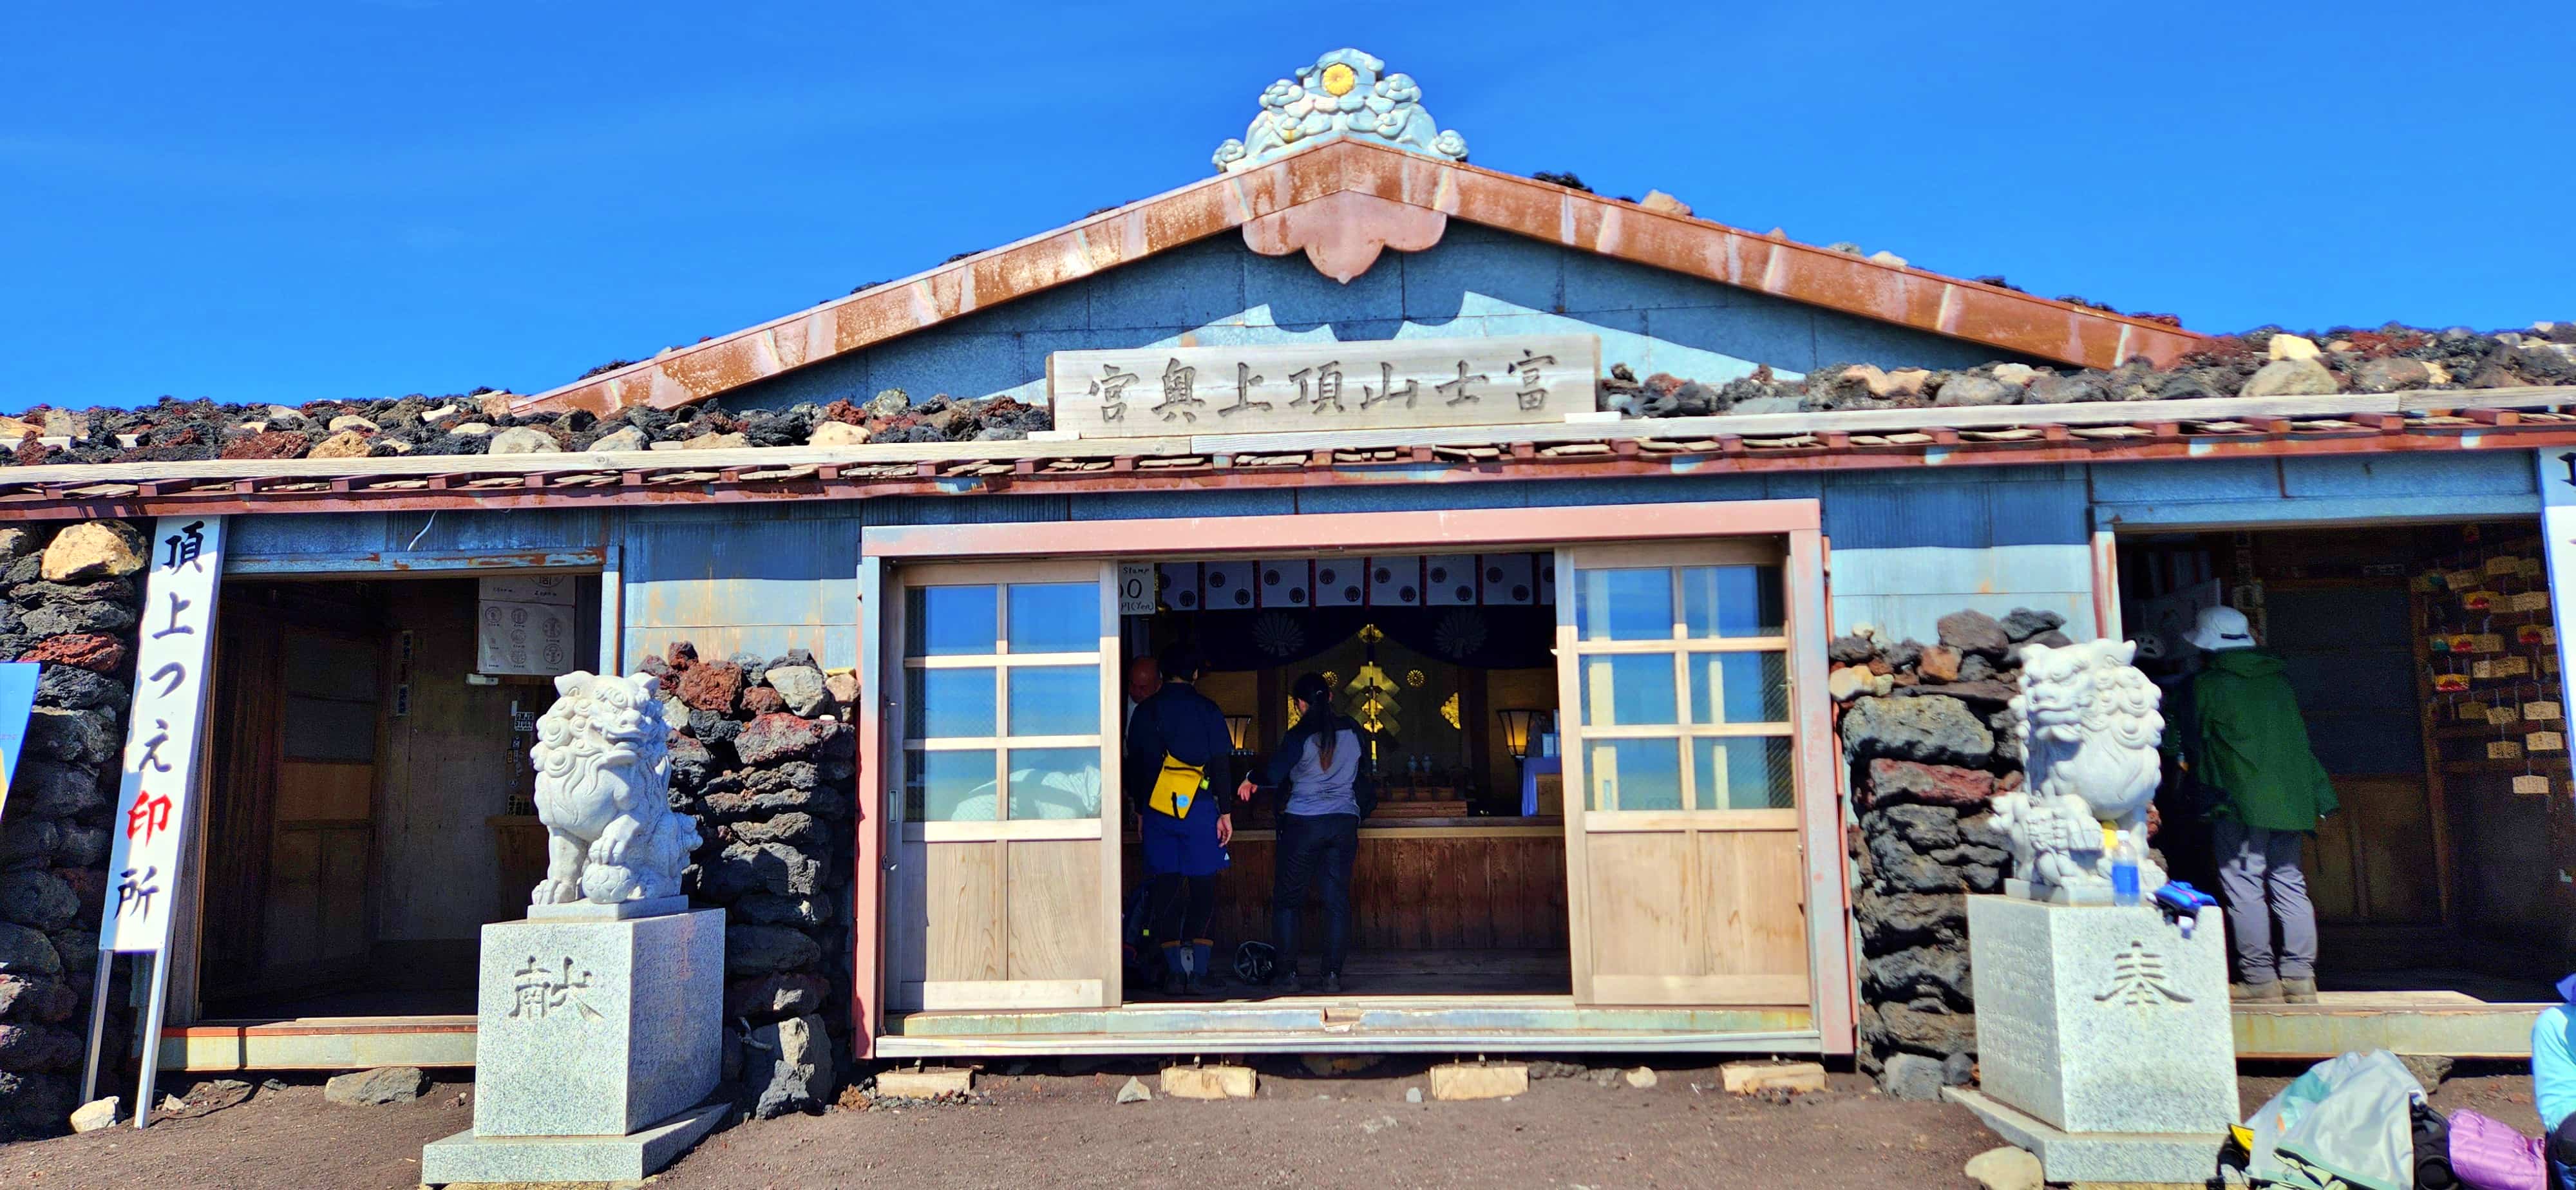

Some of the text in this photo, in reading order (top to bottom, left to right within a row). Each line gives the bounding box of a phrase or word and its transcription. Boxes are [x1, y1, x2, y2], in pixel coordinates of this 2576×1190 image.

[114, 520, 205, 922] 頂上つえ印所
[508, 955, 608, 1020] 献
[2094, 940, 2195, 1015] 奉
